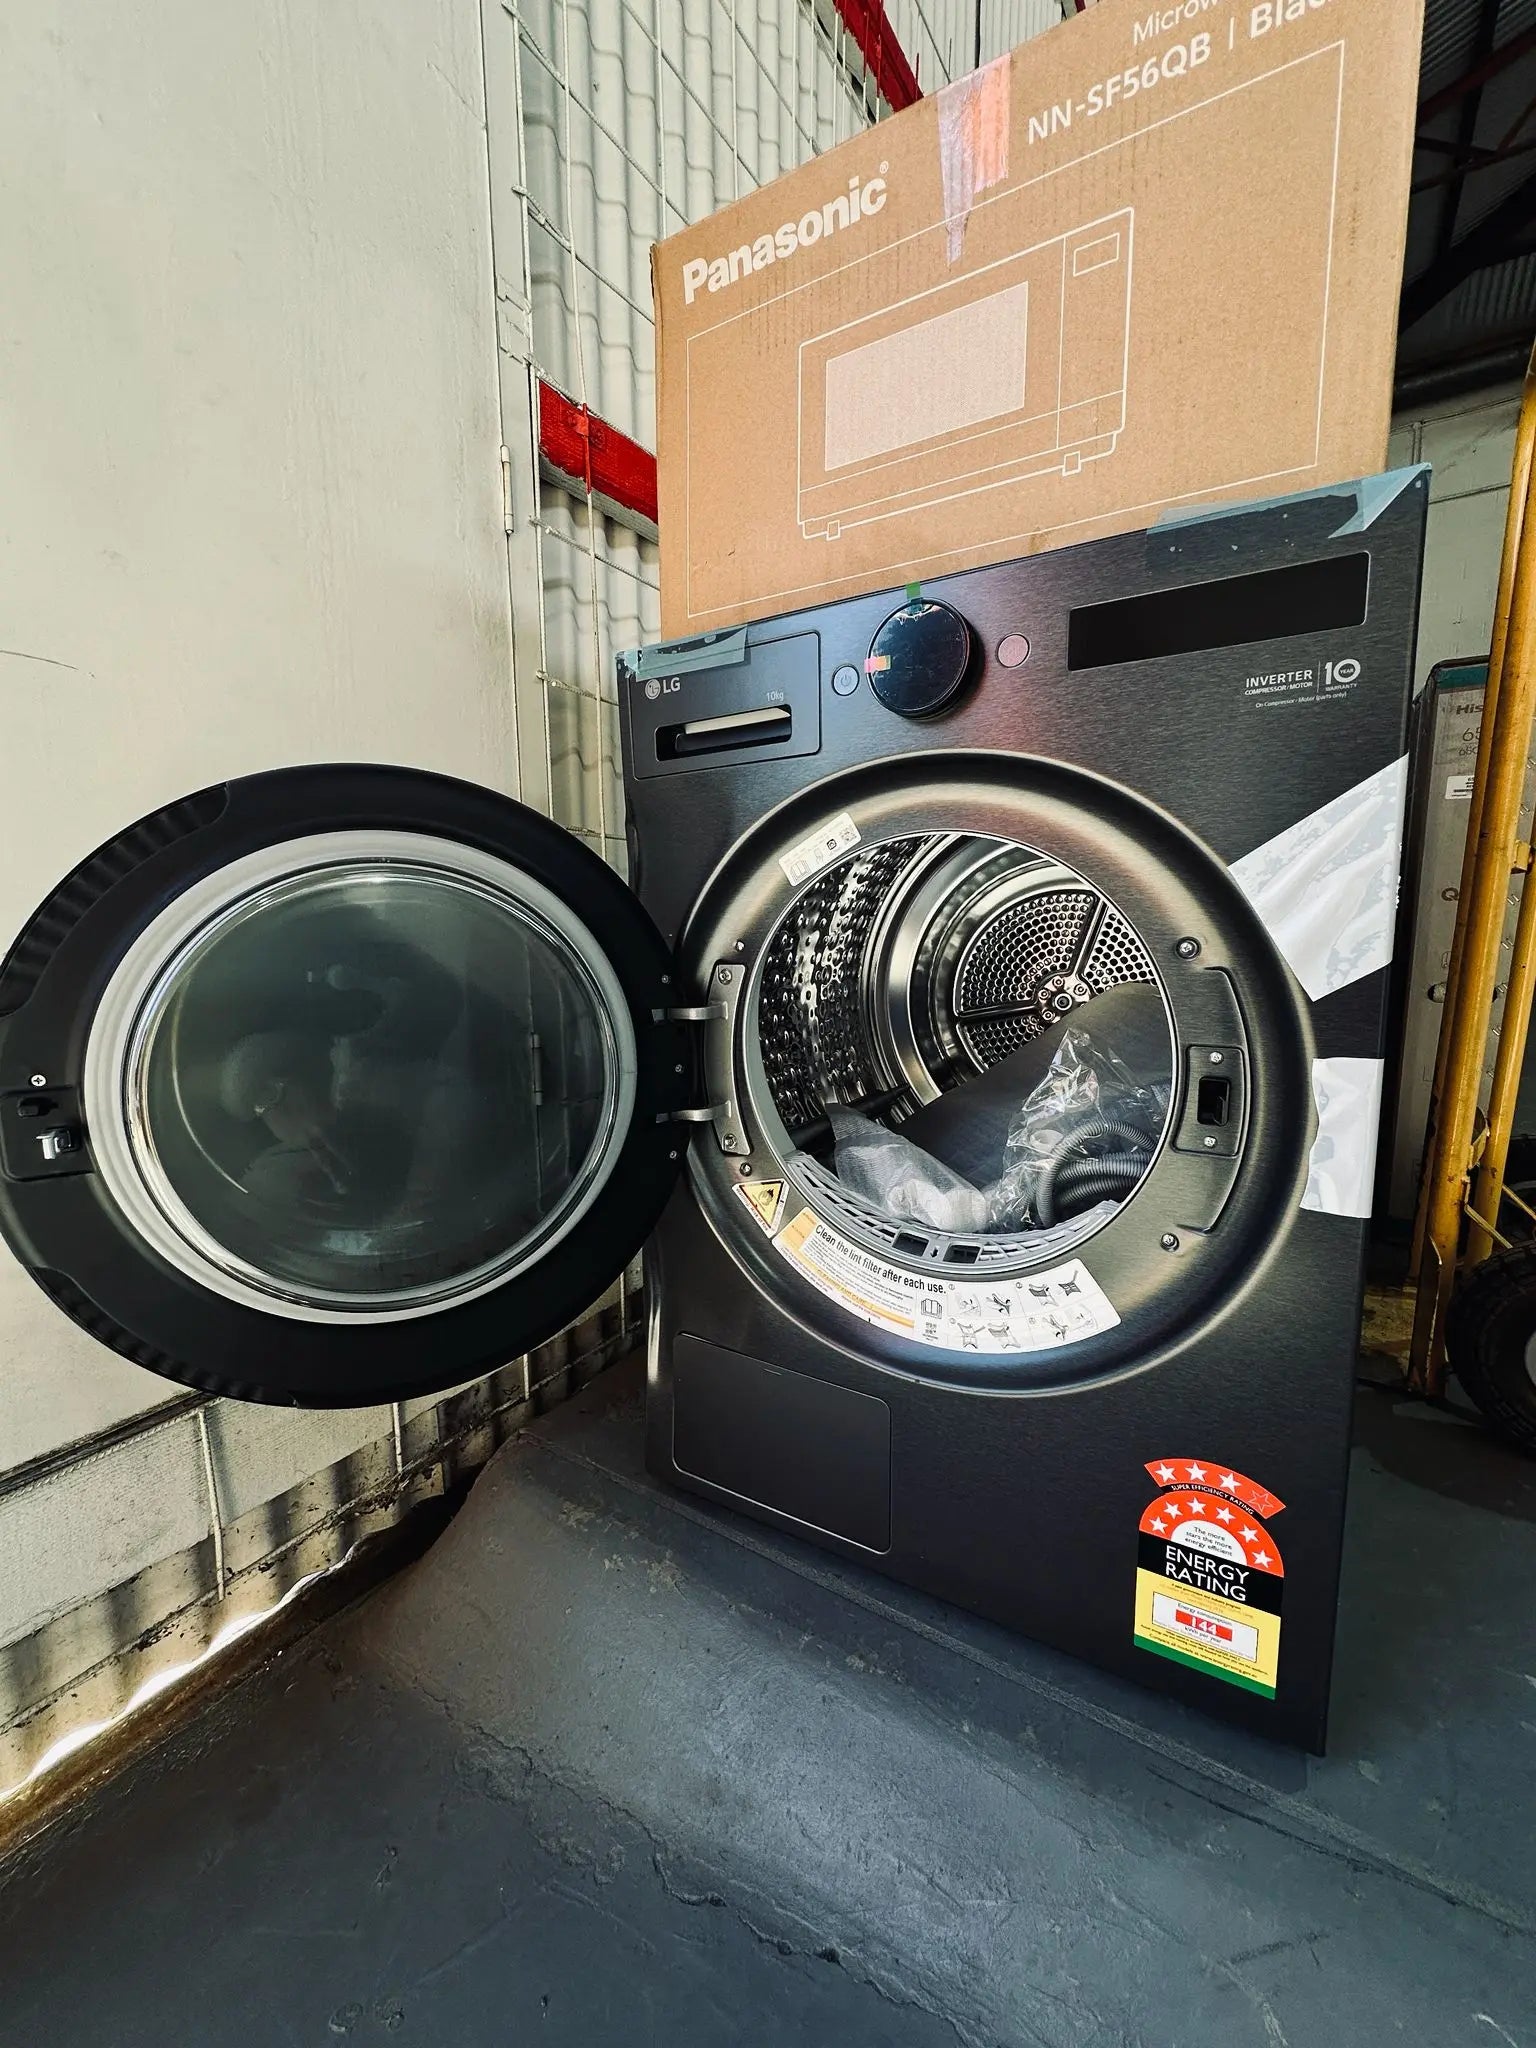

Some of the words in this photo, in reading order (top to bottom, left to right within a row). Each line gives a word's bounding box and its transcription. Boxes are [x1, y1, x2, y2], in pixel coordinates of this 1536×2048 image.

[1027, 31, 1211, 144] NN-SF56QB
[1245, 669, 1313, 688] INVERTER
[1324, 658, 1361, 685] 10
[662, 677, 681, 694] LG
[766, 691, 784, 702] 10kg
[815, 1224, 836, 1246] Clean
[836, 1240, 849, 1255] the
[849, 1248, 862, 1264] lint
[862, 1257, 882, 1275] filter
[882, 1268, 903, 1282] after
[903, 1277, 925, 1290] each
[927, 1282, 947, 1294] use.
[1191, 1484, 1228, 1499] EFFICIENCY
[1229, 1496, 1255, 1515] RATING
[1186, 1531, 1201, 1540] stars
[1202, 1535, 1213, 1544] the
[1214, 1541, 1233, 1550] more
[1194, 1526, 1207, 1535] The
[1207, 1532, 1226, 1541] more
[1184, 1537, 1206, 1549] energy
[1207, 1544, 1233, 1556] efficient
[1165, 1545, 1250, 1585] ENERGY
[1165, 1561, 1247, 1602] RATING
[1177, 1602, 1196, 1614] Energy
[1191, 1616, 1217, 1636] 144
